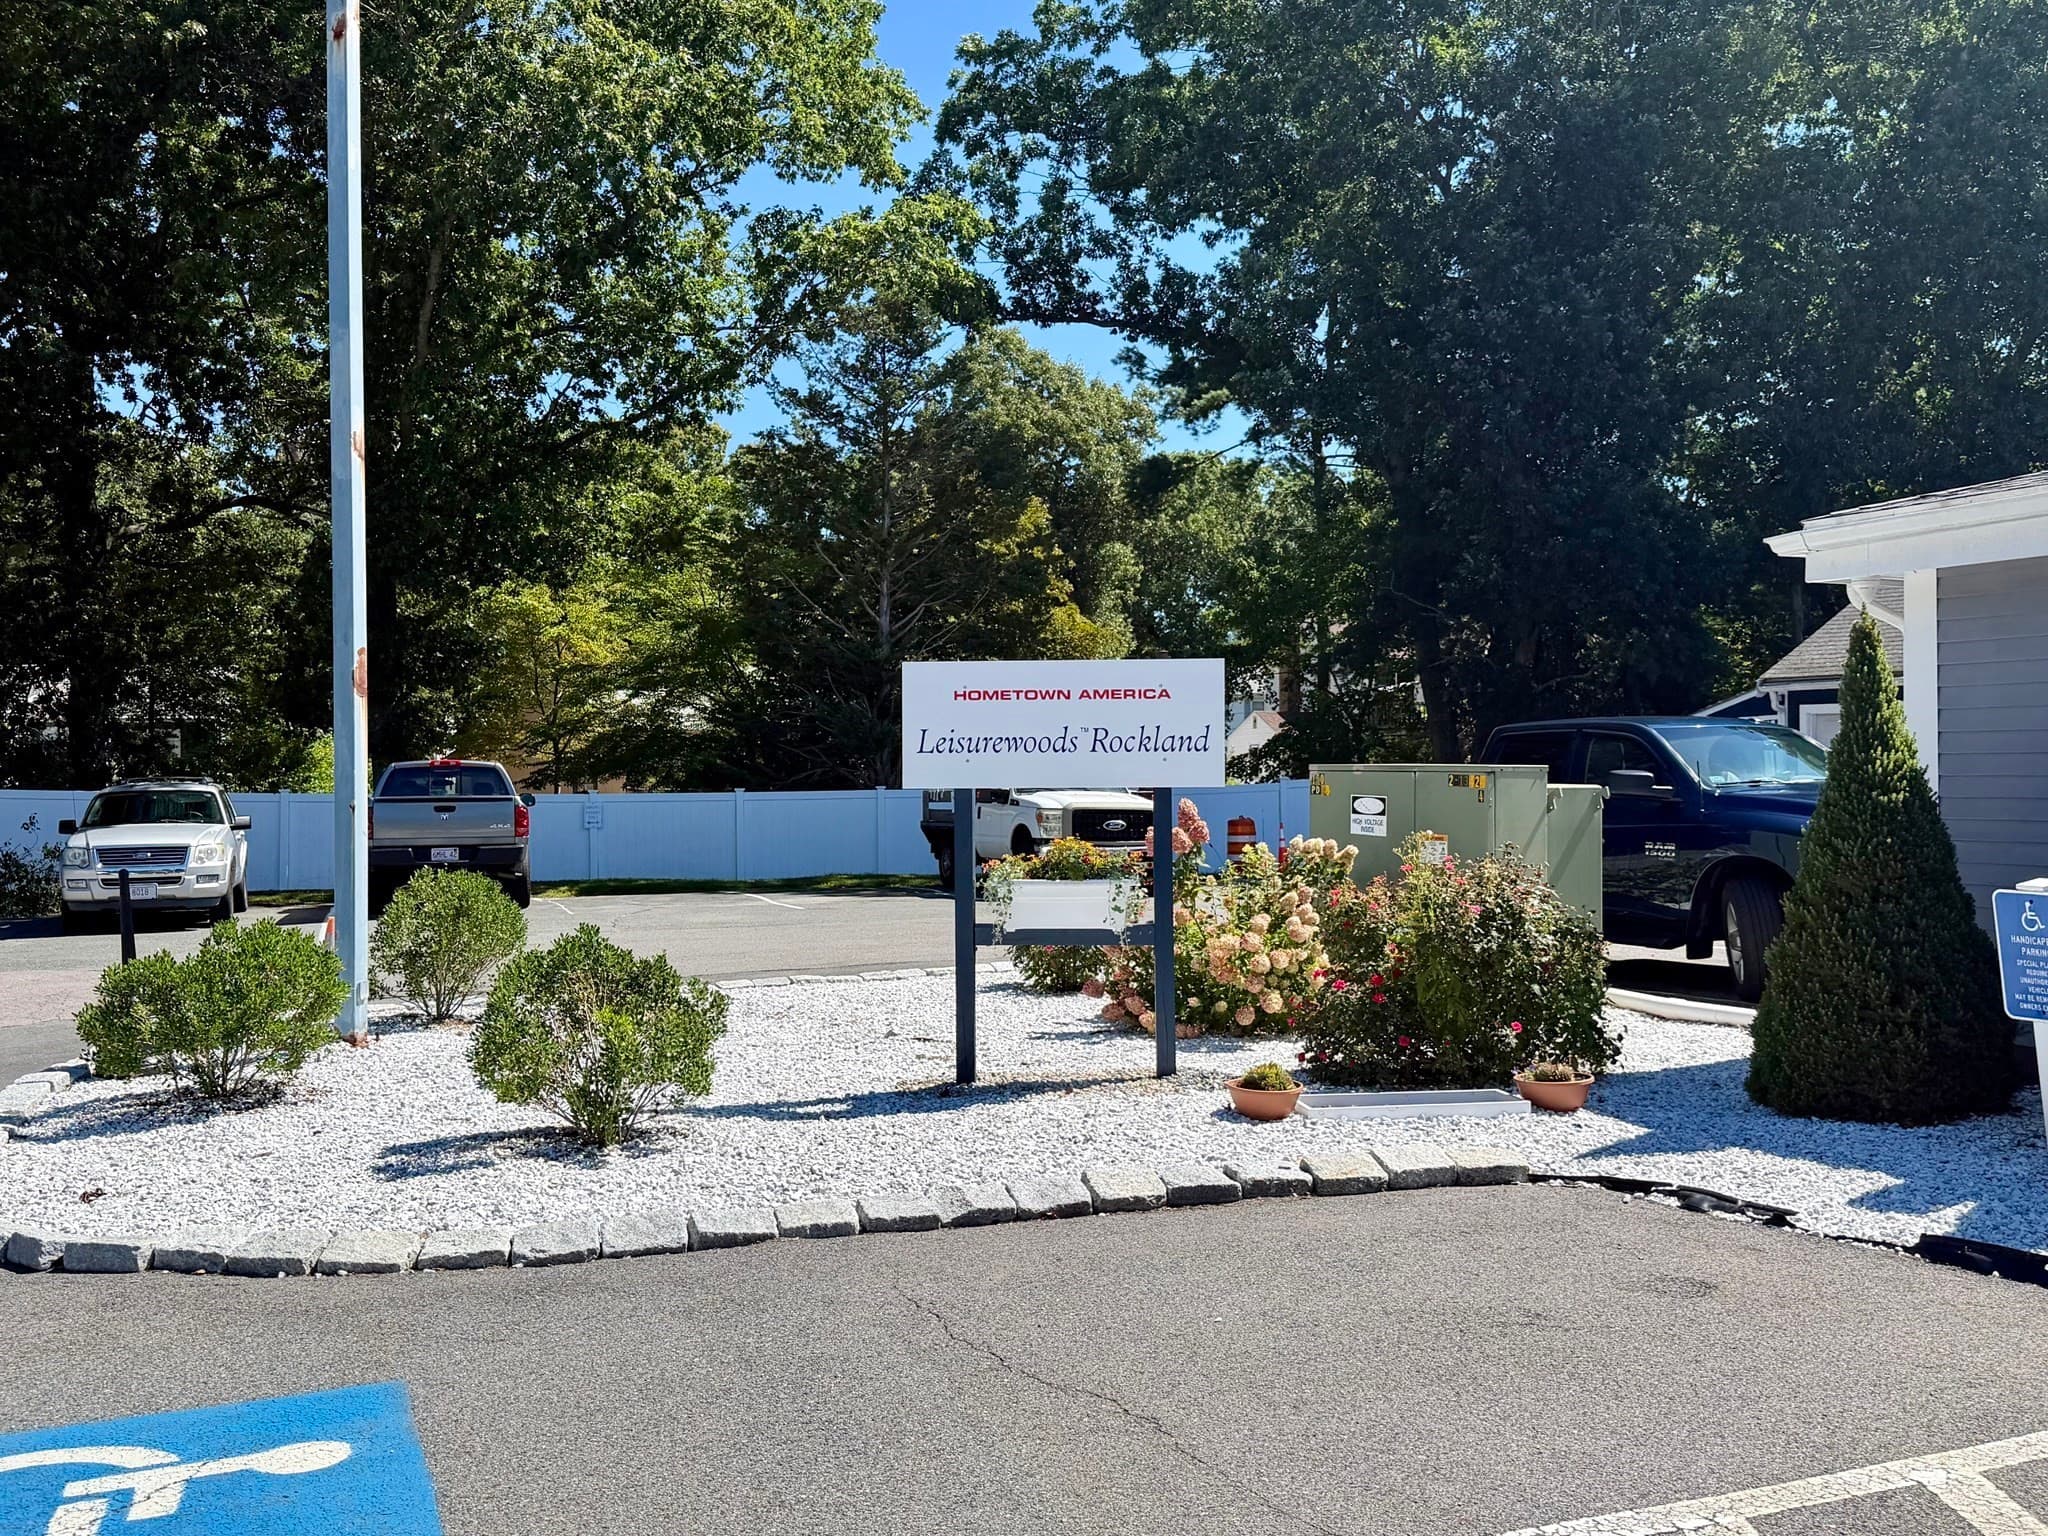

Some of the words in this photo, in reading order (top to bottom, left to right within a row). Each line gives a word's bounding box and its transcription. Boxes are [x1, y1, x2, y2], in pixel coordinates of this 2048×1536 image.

[953, 689, 1071, 701] HOMETOWN
[1078, 688, 1171, 700] AMERICA
[916, 726, 1079, 754] Leisurewoods
[1089, 725, 1210, 754] Rockland
[1644, 841, 1676, 850] RAM
[1645, 849, 1676, 857] 1500
[2021, 947, 2048, 958] PARKIN
[2016, 959, 2040, 968] SPECIAL
